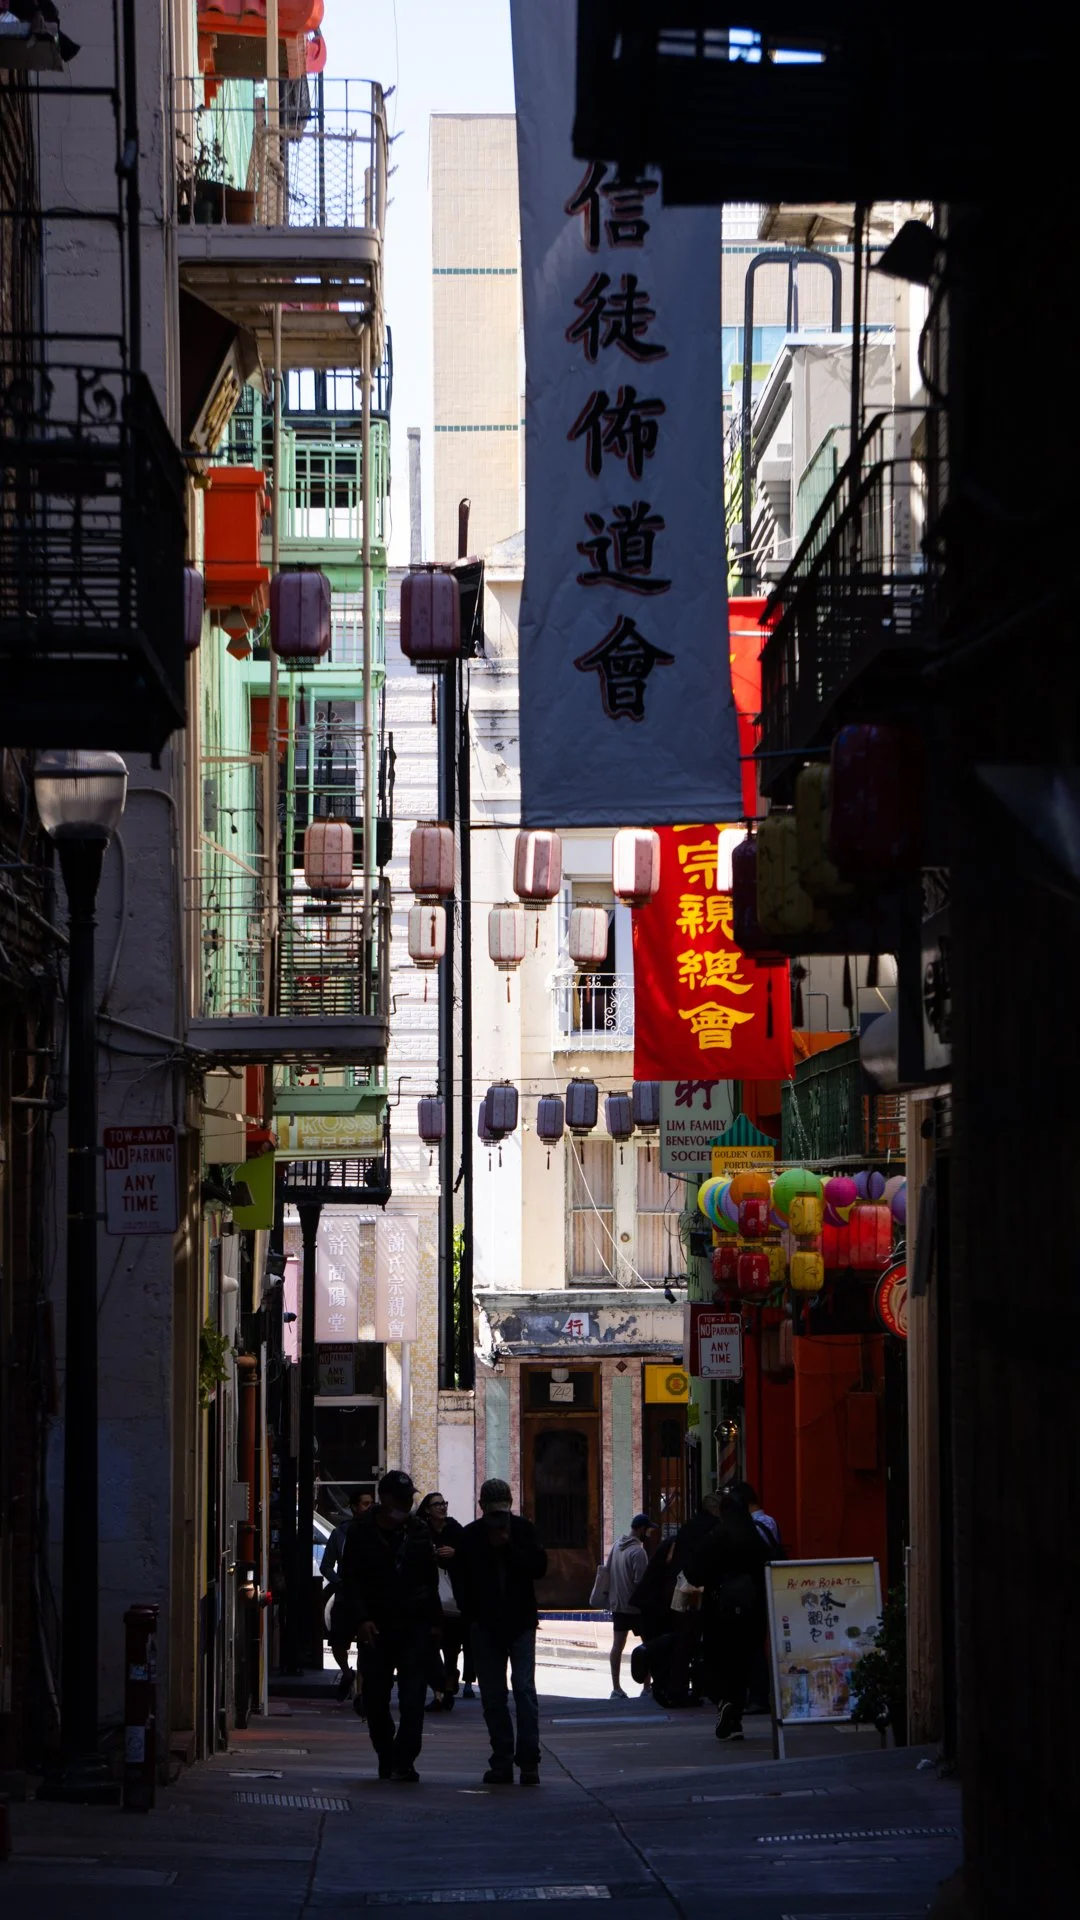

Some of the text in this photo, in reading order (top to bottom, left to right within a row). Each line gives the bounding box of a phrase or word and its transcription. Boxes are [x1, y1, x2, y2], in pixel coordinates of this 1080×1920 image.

[675, 825, 755, 1050] 宗親總會
[667, 1120, 727, 1131] LIM FAMILY
[110, 1129, 170, 1143] TOW-AWAY
[106, 1147, 172, 1168] NO PARKING
[671, 1151, 712, 1161] SOCIET
[714, 1151, 773, 1159] GOLDEN GATE
[124, 1174, 156, 1191] ANY
[121, 1195, 159, 1211] TIME
[565, 1319, 583, 1336] 行
[700, 1324, 738, 1336] NO PARKING
[711, 1342, 730, 1351] ANY
[710, 1354, 730, 1364] TIME
[328, 1367, 344, 1375] ANY
